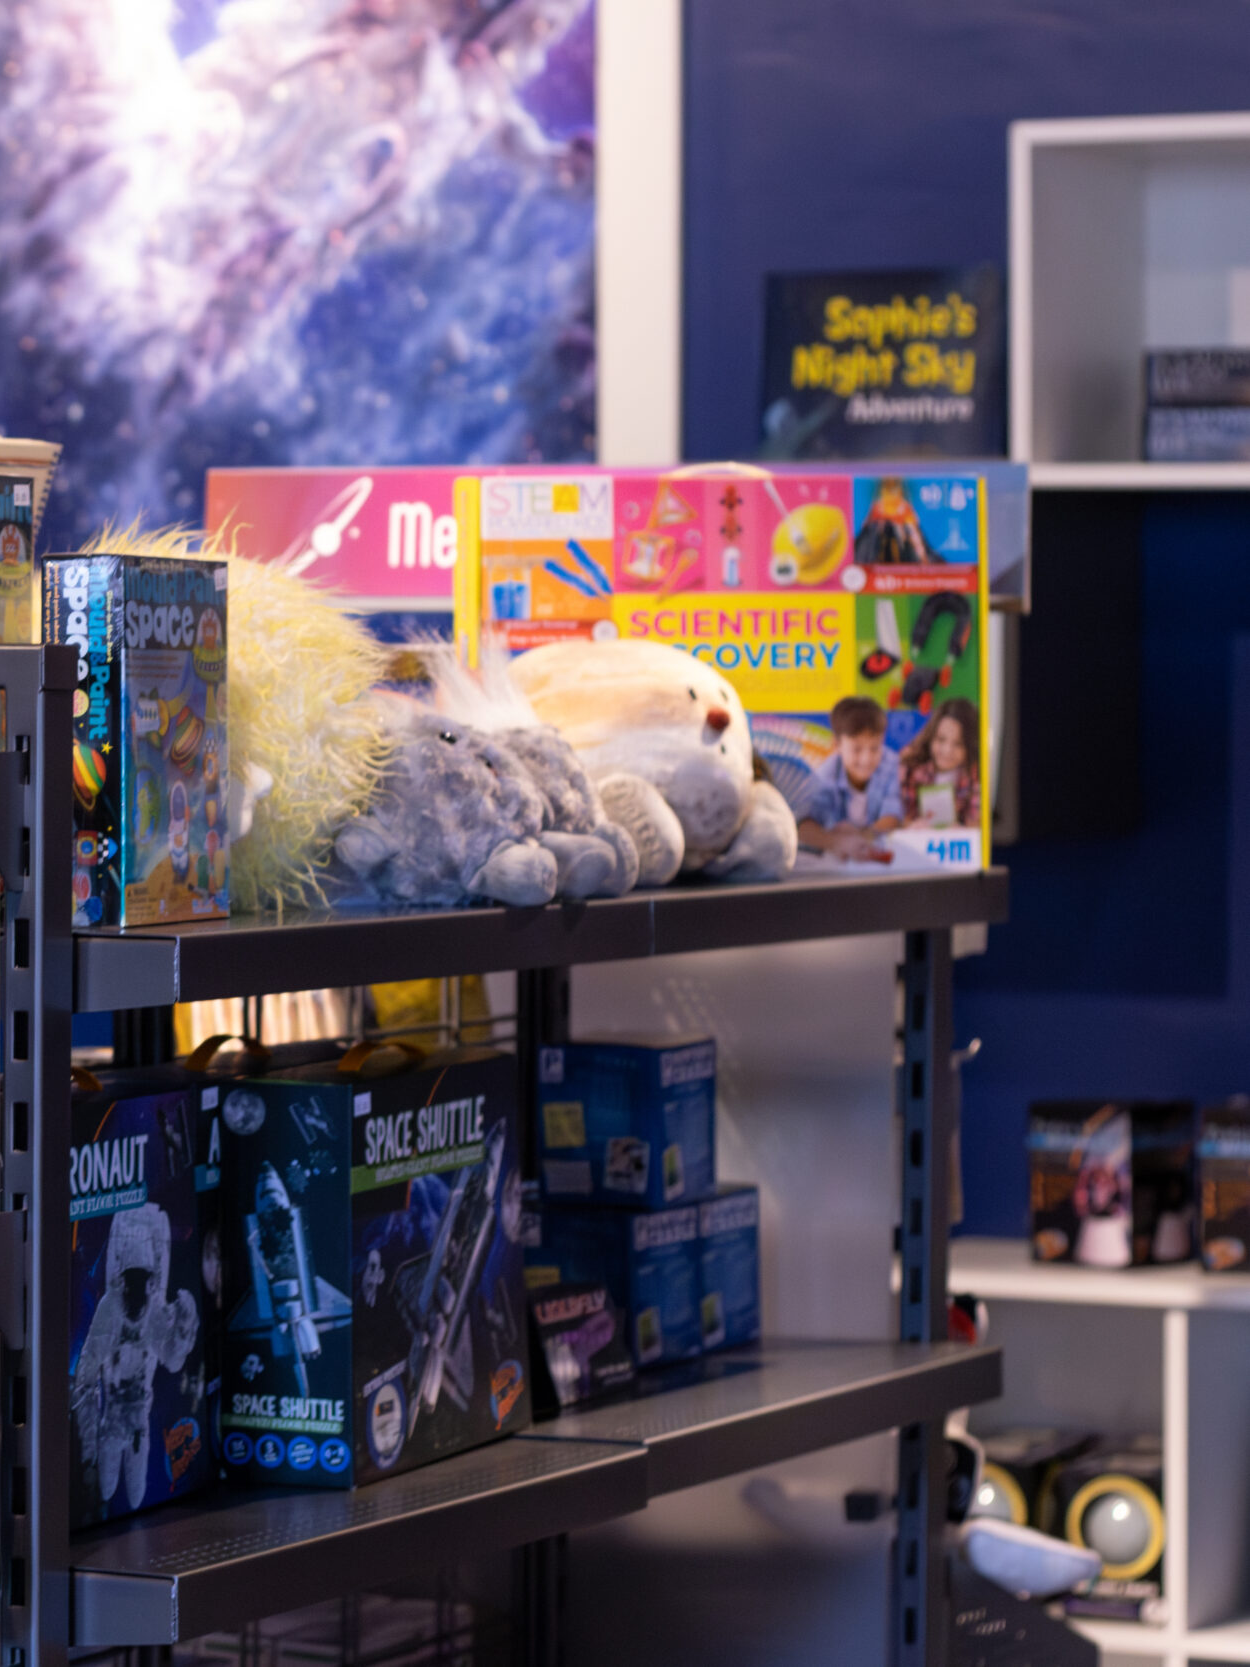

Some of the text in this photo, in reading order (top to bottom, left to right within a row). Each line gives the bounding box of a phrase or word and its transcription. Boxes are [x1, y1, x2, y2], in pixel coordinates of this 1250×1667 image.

[823, 292, 977, 348] Sophie's
[791, 341, 976, 398] Night Sky
[845, 391, 975, 424] Adventure
[630, 609, 840, 637] SCIENTIFIC
[88, 665, 111, 740] Paint
[366, 1110, 414, 1165] SPACE
[417, 1094, 486, 1152] SHUTTLE
[233, 1393, 276, 1417] SPACE
[280, 1396, 345, 1422] SHUTTLE
